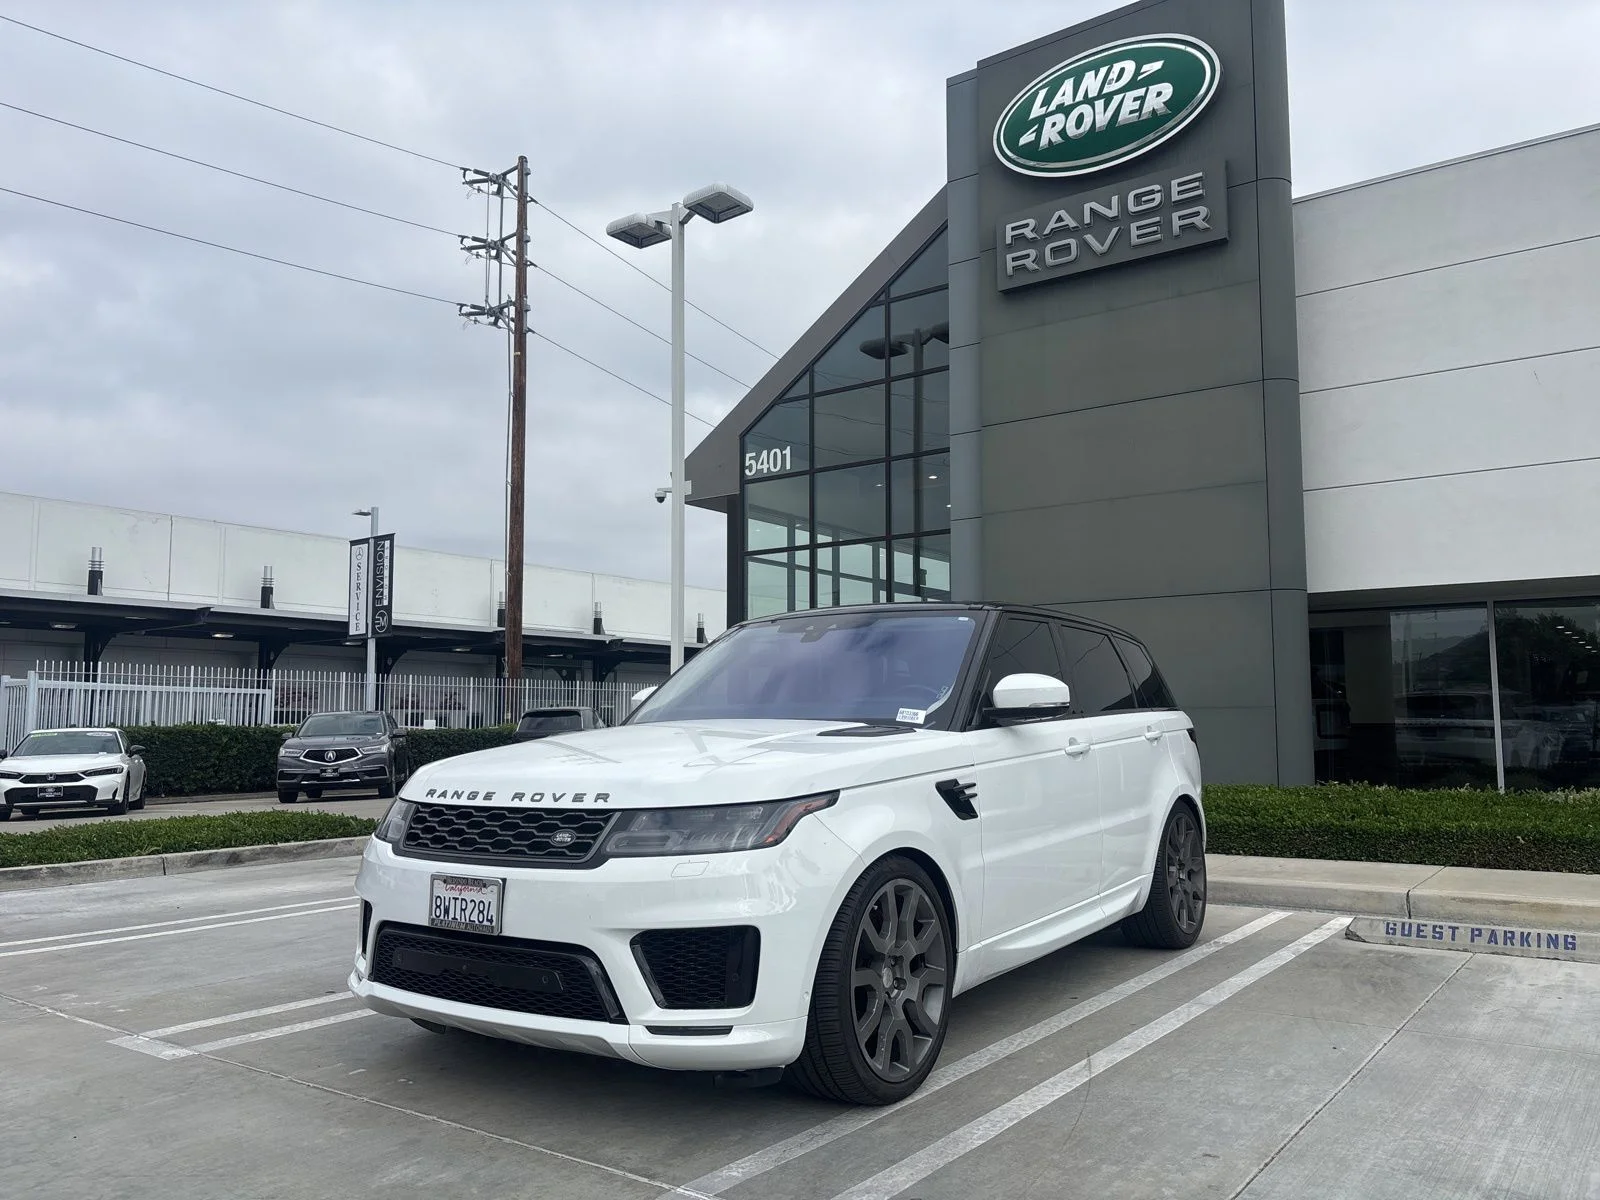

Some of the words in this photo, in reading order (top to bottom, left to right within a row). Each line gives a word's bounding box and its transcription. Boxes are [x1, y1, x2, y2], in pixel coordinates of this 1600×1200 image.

[1028, 59, 1136, 120] LAND
[1038, 82, 1173, 151] ROVER
[1005, 172, 1206, 246] RANGE
[1006, 205, 1213, 277] ROVER
[745, 446, 791, 476] 5401
[375, 541, 385, 607] ENVISION
[425, 788, 496, 801] RANGE
[510, 792, 611, 803] ROVER
[434, 895, 494, 925] 8WIR284
[444, 884, 487, 896] California
[1385, 921, 1460, 942] GUEST
[1470, 928, 1577, 950] PARKING
